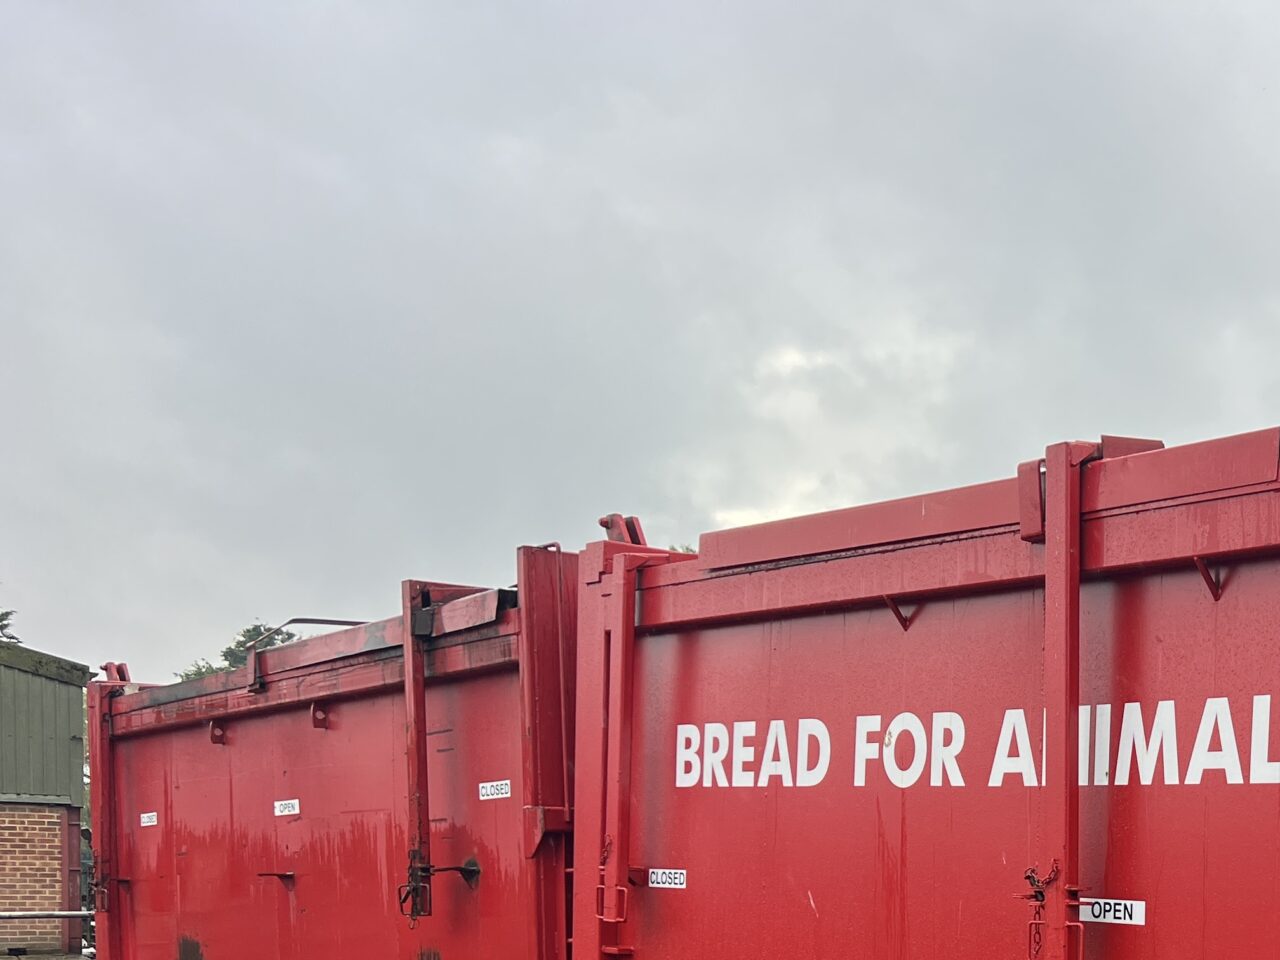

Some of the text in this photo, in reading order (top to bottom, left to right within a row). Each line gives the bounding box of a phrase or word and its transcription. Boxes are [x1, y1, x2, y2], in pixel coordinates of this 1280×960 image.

[675, 718, 831, 788] BREAD
[854, 711, 966, 789] FOR
[481, 783, 510, 797] CLOSED
[280, 802, 296, 813] OPEN
[650, 871, 685, 885] CLOSED
[1091, 901, 1133, 921] OPEN
